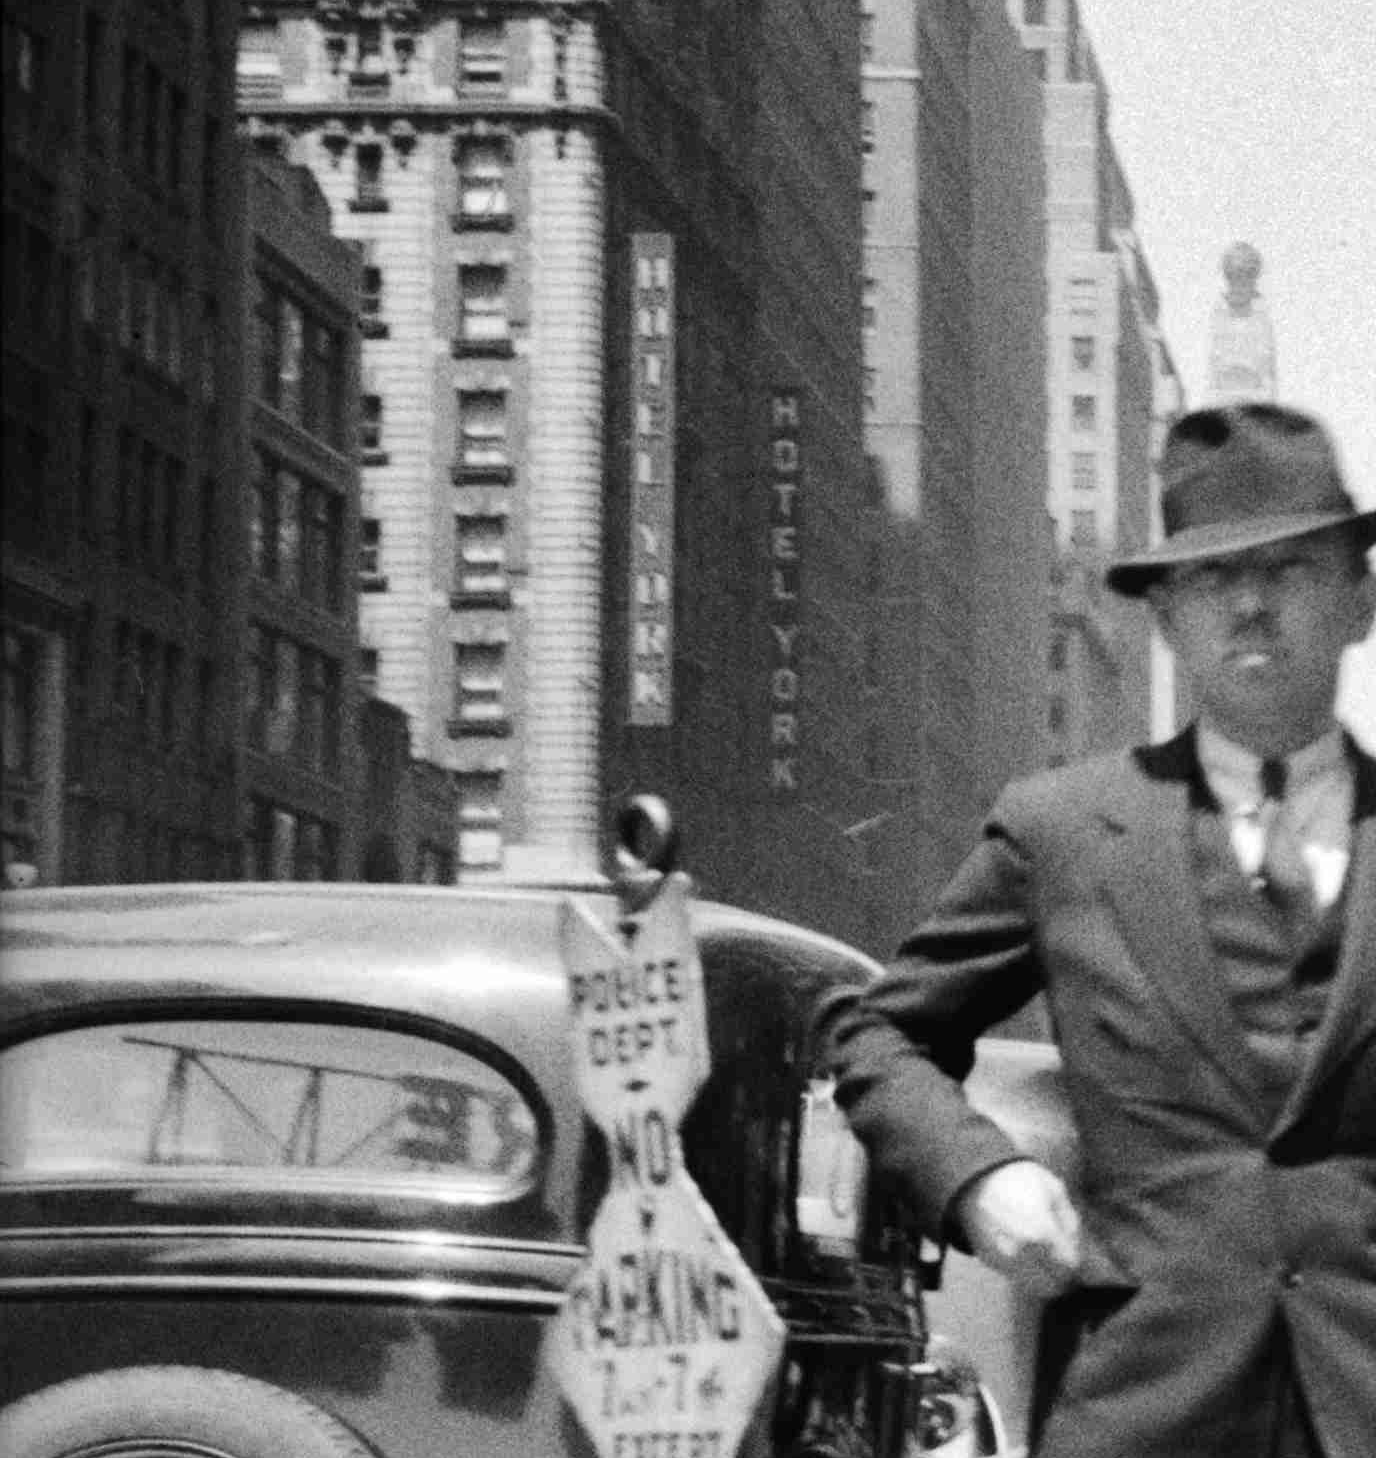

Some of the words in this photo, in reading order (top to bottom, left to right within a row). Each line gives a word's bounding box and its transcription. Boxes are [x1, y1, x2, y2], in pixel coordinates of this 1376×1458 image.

[771, 395, 799, 602] HOTEL
[771, 622, 799, 789] YORK
[572, 960, 681, 1014] POLICE
[613, 1108, 669, 1187] NO
[569, 1248, 741, 1353] PARKING
